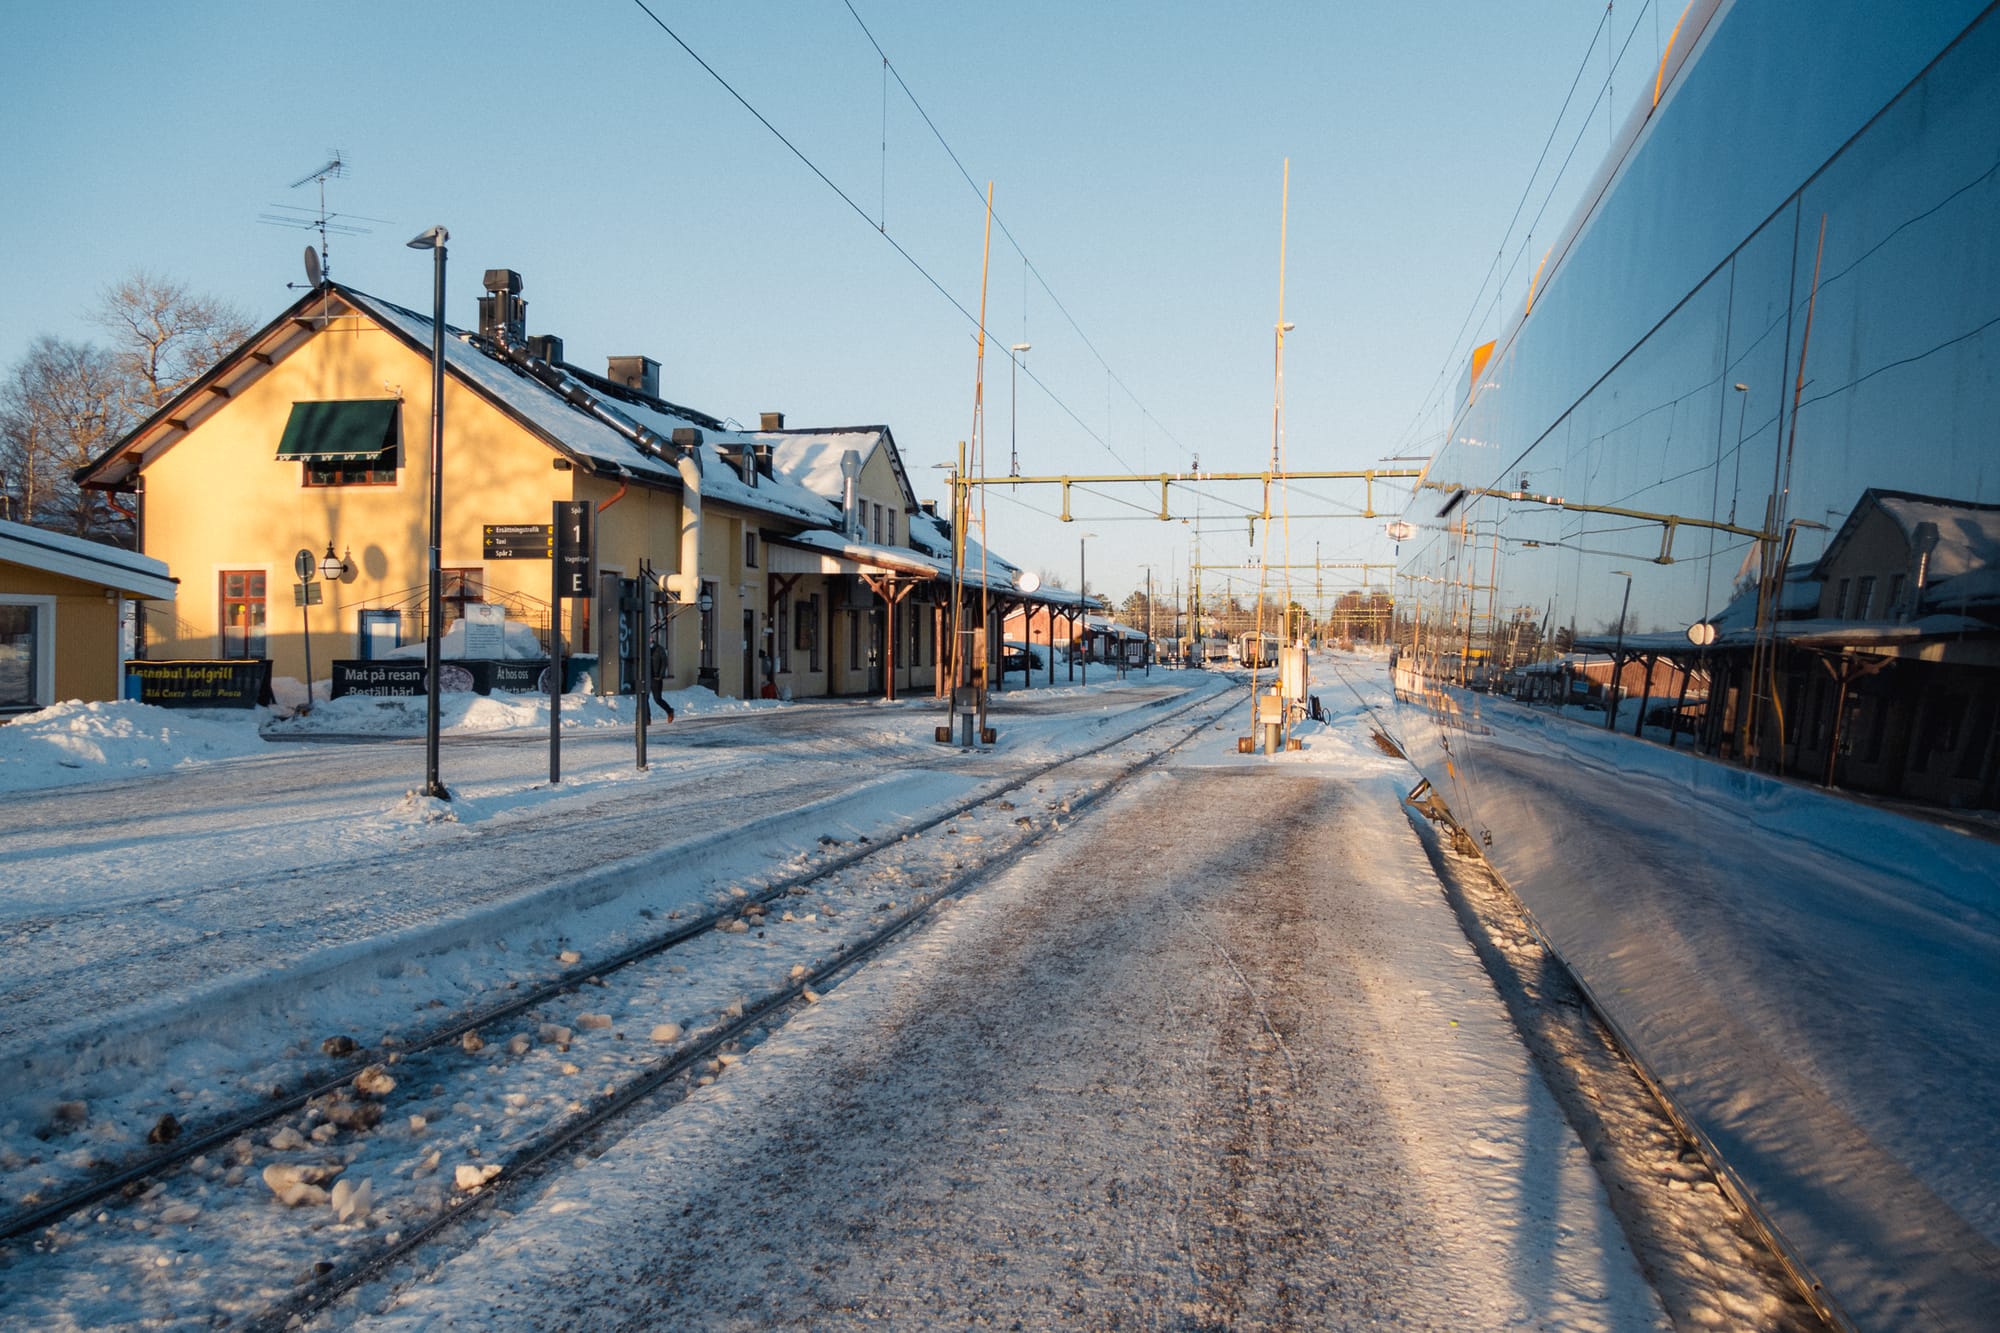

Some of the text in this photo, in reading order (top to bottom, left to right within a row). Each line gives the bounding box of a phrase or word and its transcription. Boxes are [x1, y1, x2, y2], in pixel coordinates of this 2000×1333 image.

[495, 526, 539, 534] Ersättningstrafik
[573, 525, 581, 543] 1
[495, 550, 508, 558] Spår
[572, 573, 582, 591] E
[345, 668, 420, 684] Mat på resan
[505, 667, 517, 680] hos
[517, 670, 529, 680] oss
[192, 689, 212, 697] Grill
[391, 686, 414, 697] här!
